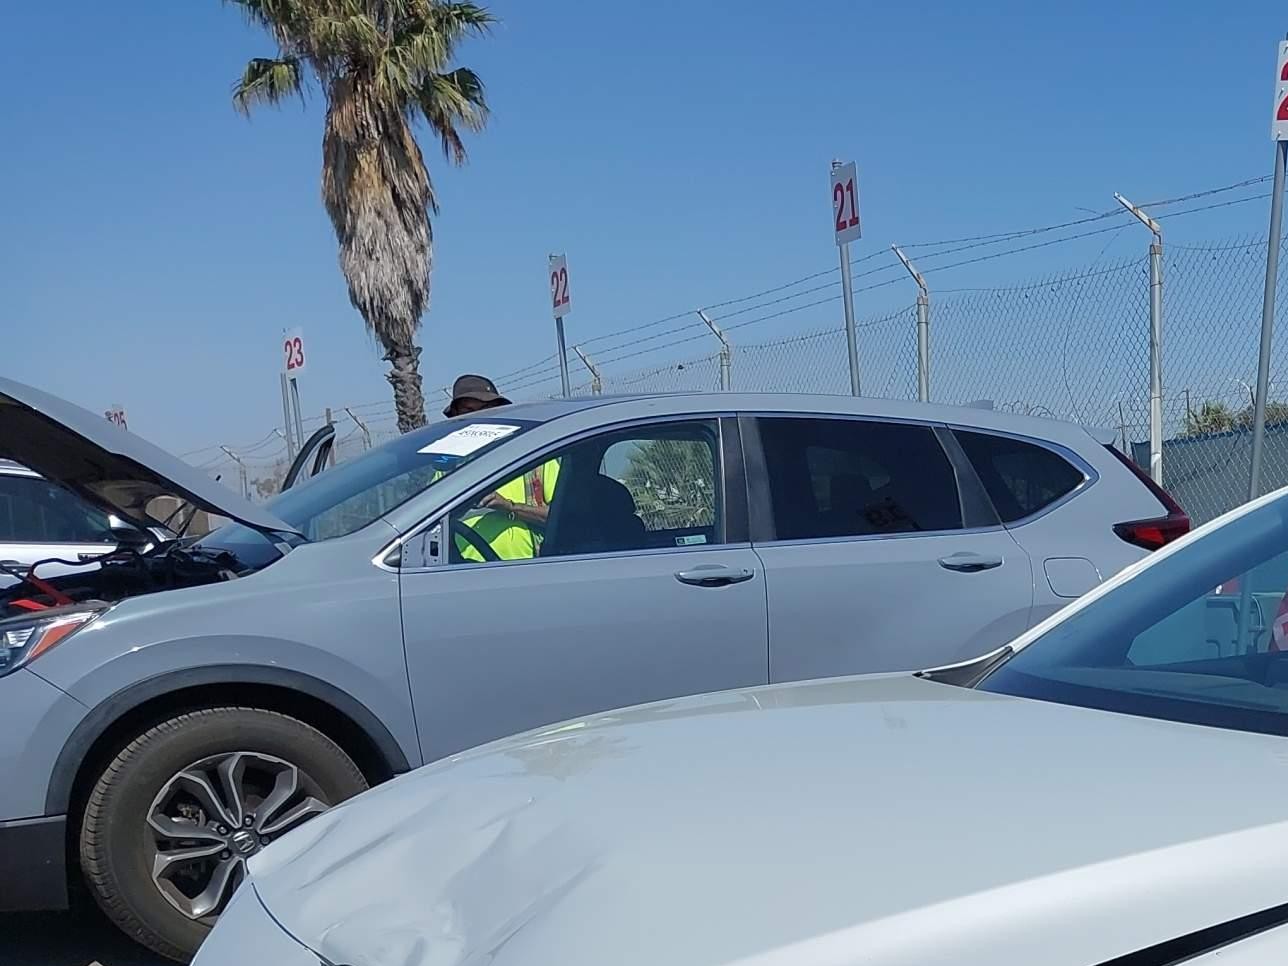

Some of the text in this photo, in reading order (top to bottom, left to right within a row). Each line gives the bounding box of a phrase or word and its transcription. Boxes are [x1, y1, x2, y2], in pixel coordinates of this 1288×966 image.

[833, 178, 859, 232] 21
[551, 267, 569, 308] 22
[284, 337, 304, 370] 23
